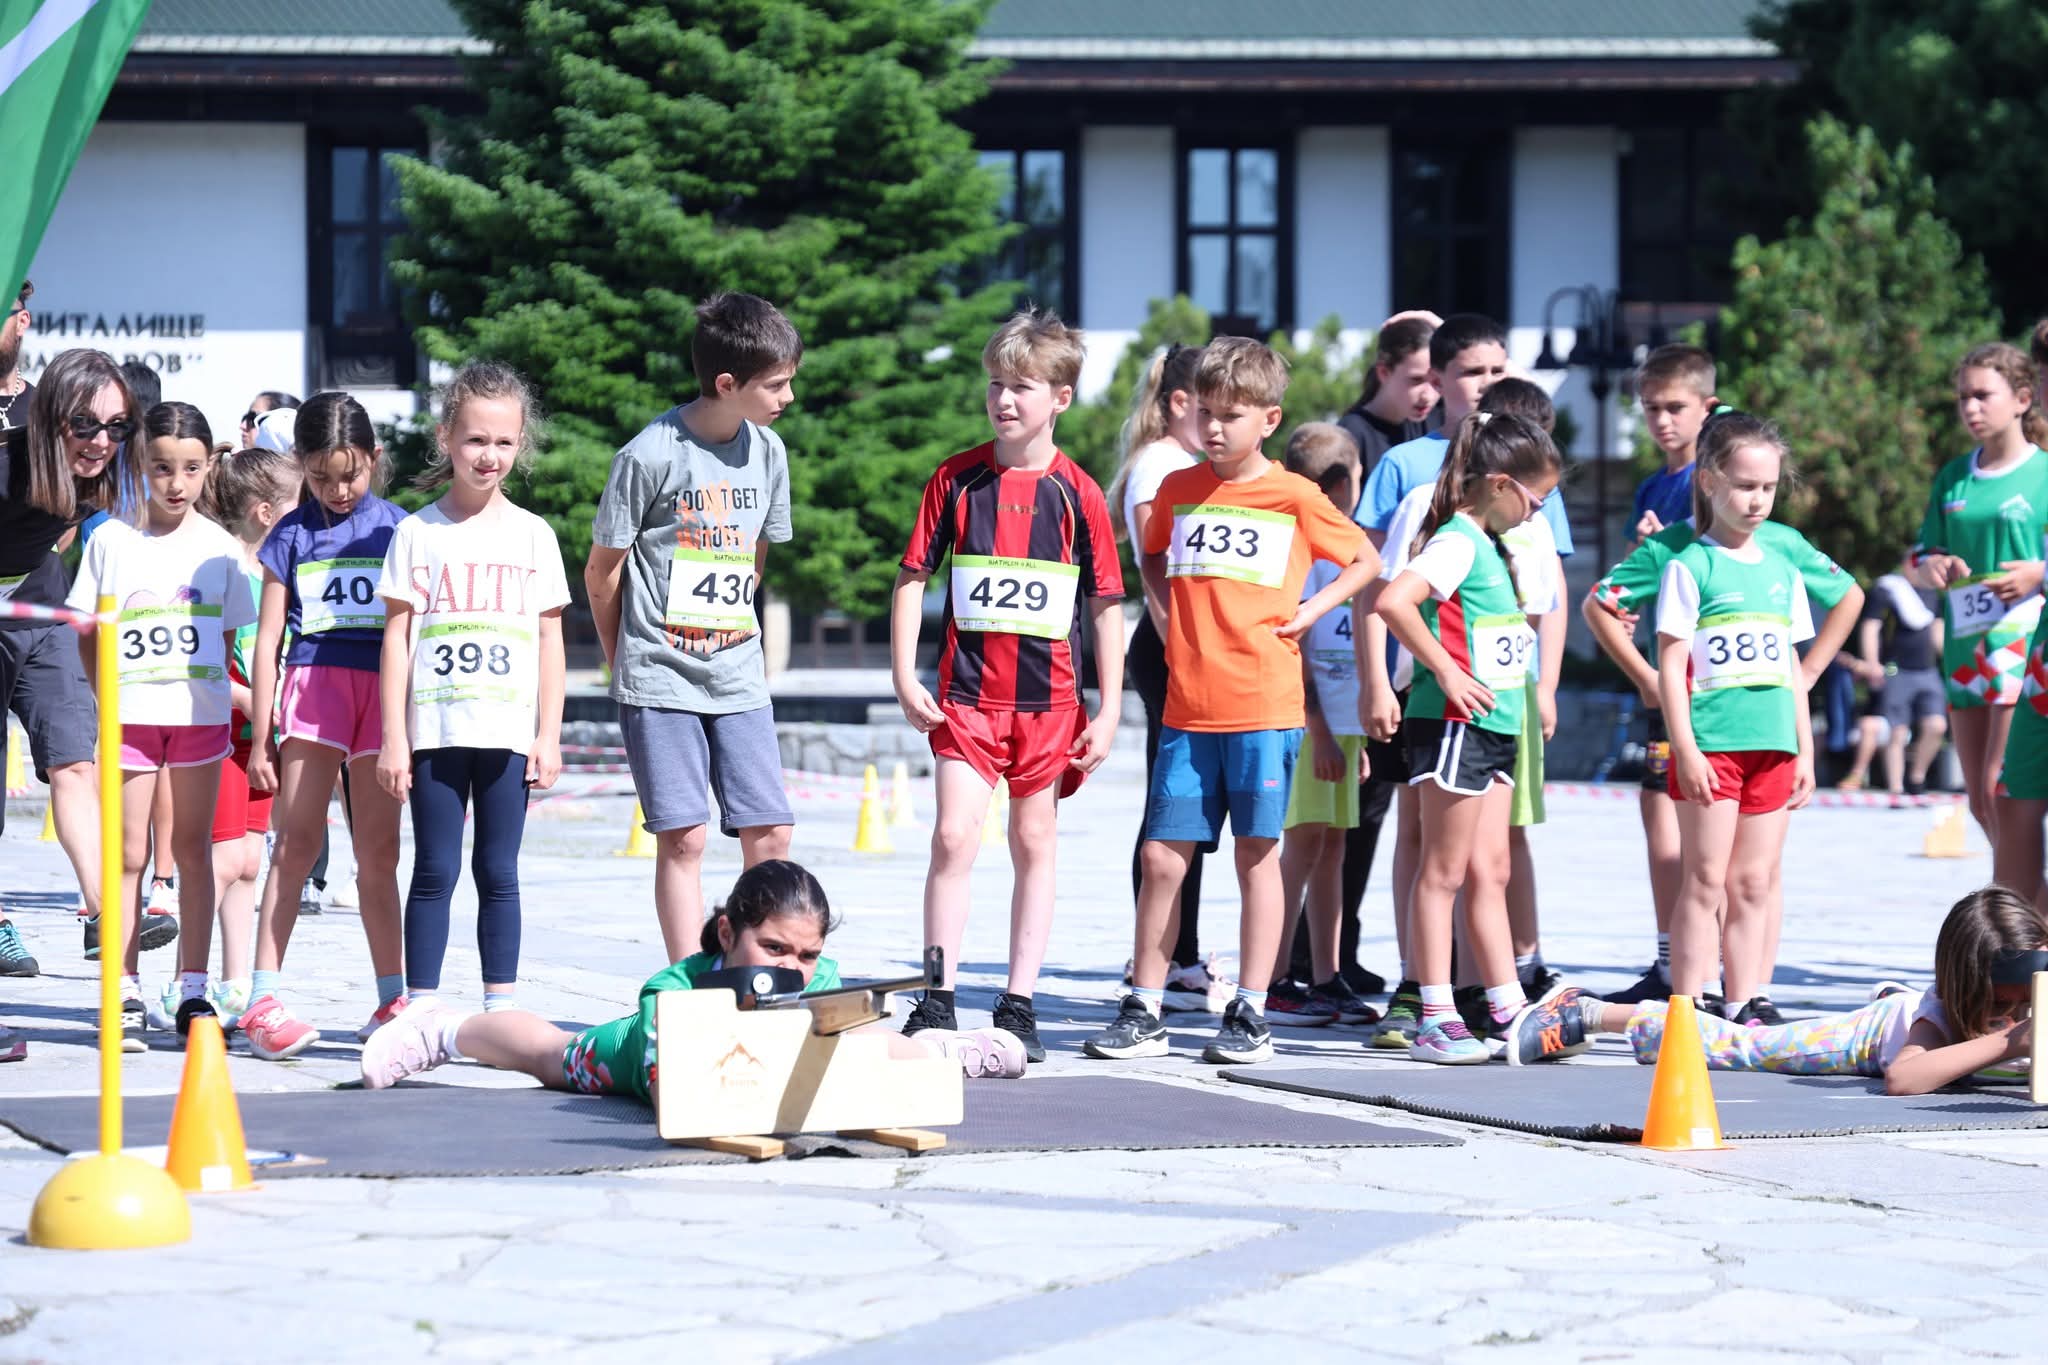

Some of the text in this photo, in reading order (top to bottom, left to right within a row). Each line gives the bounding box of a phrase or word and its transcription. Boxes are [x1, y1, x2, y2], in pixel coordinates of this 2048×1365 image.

[732, 488, 758, 510] GET
[1186, 523, 1259, 557] 433
[411, 563, 537, 616] SALTY
[692, 573, 754, 605] 430
[969, 577, 1048, 611] 429
[123, 625, 200, 660] 399
[1708, 633, 1780, 665] 388
[434, 643, 511, 676] 398
